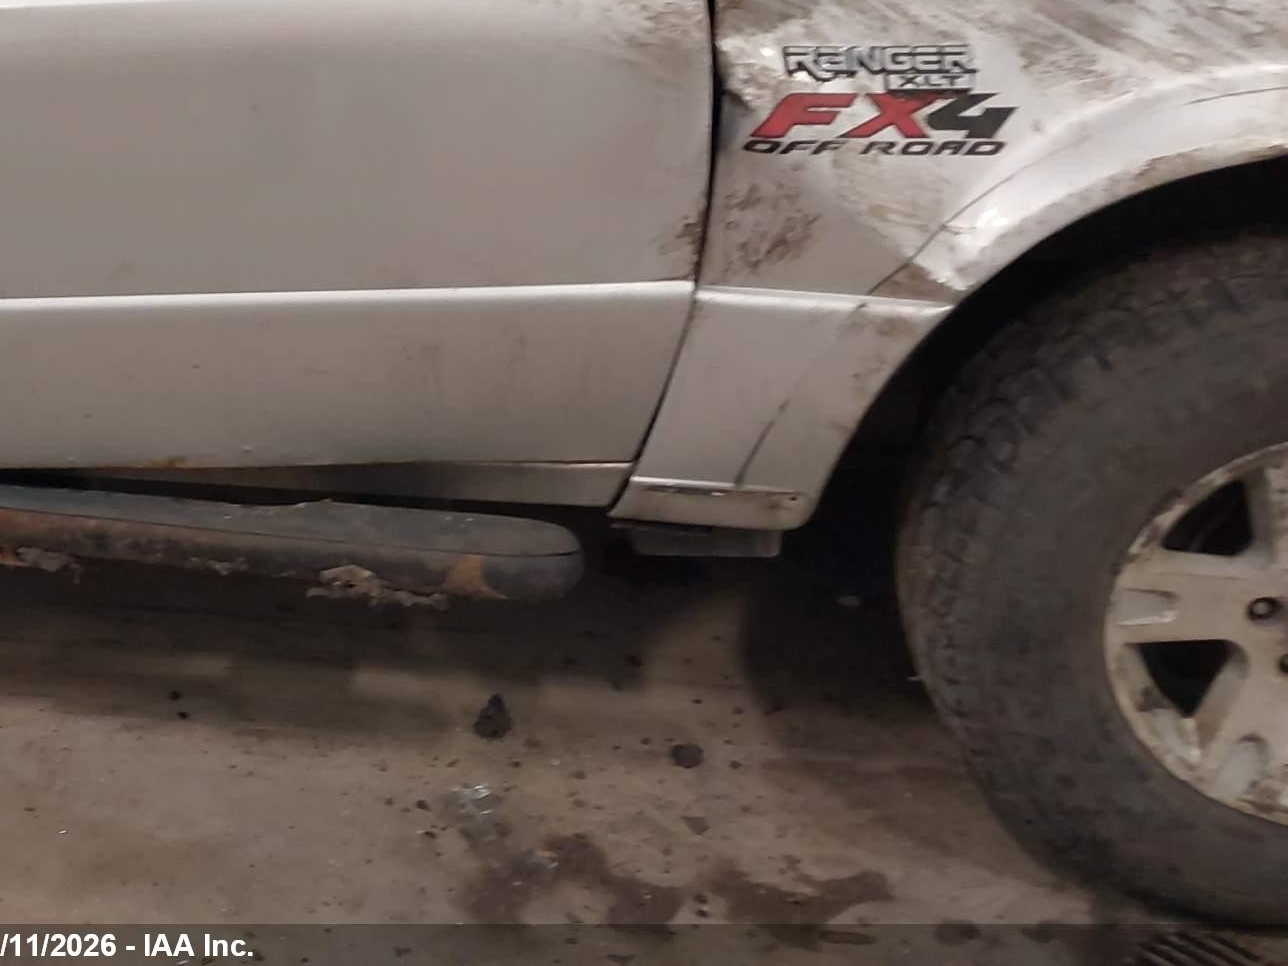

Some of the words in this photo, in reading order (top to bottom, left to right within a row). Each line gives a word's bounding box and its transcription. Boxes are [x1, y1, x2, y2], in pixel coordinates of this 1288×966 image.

[896, 73, 964, 89] XLT
[750, 92, 1019, 139] FX4
[743, 140, 850, 155] OFF
[859, 140, 1007, 156] ROAD
